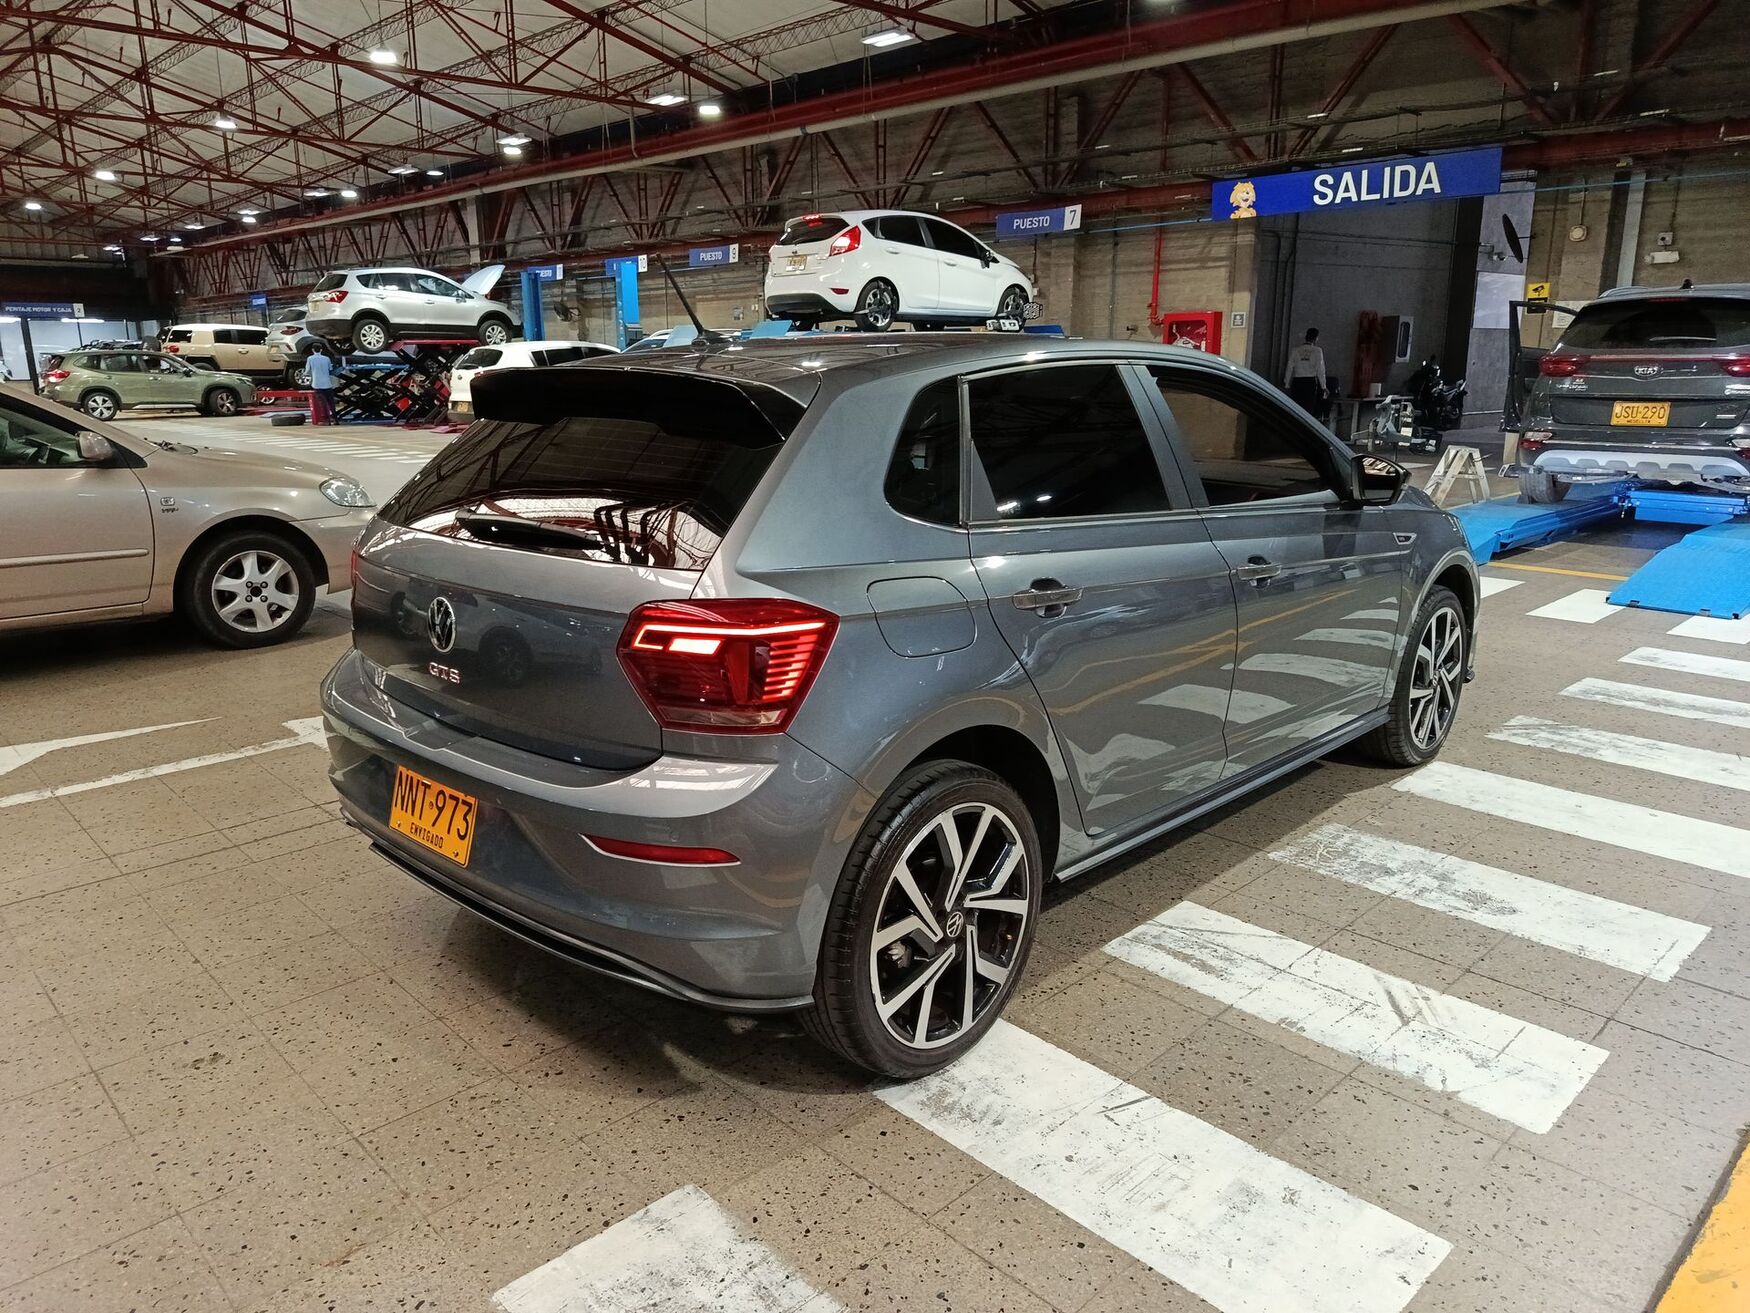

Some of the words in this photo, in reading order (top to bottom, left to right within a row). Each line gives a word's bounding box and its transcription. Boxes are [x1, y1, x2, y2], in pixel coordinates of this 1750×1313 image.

[1313, 161, 1441, 205] SALIDA
[1013, 215, 1050, 230] PUESTO
[1069, 209, 1077, 226] 7
[700, 251, 722, 261] PUESTO
[429, 661, 460, 684] GTS
[410, 822, 444, 849] ENVIGADO
